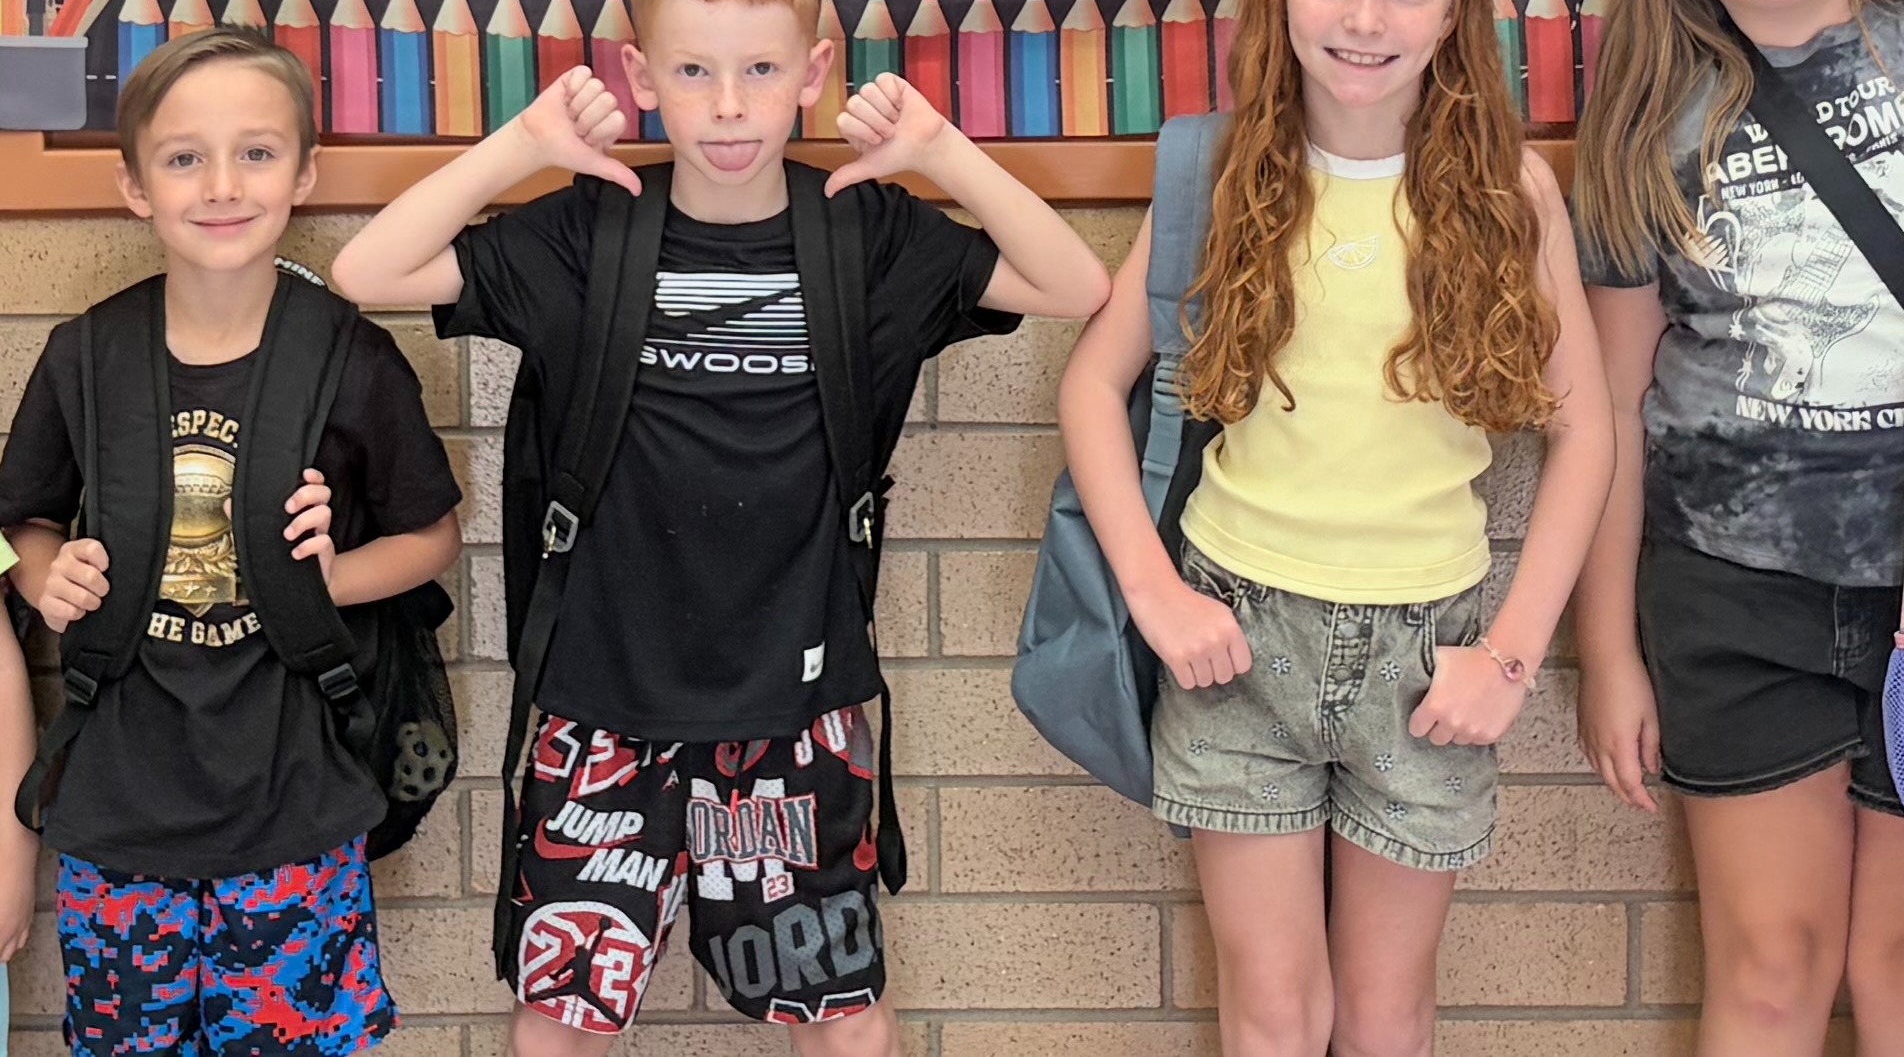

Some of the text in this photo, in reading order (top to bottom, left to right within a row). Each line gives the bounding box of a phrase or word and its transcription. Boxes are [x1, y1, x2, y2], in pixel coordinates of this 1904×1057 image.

[1834, 76, 1895, 118] TOUR
[1749, 178, 1779, 196] YORK
[640, 345, 816, 373] SWOOS
[170, 409, 240, 449] SPEC
[1736, 394, 1792, 424] NEW
[1798, 408, 1872, 432] YORK
[147, 611, 263, 647] HE GAME
[546, 800, 645, 847] JUMP
[686, 796, 817, 866] ORDAN
[576, 848, 669, 893] MAN
[766, 873, 791, 899] 23
[709, 890, 884, 1001] JORD
